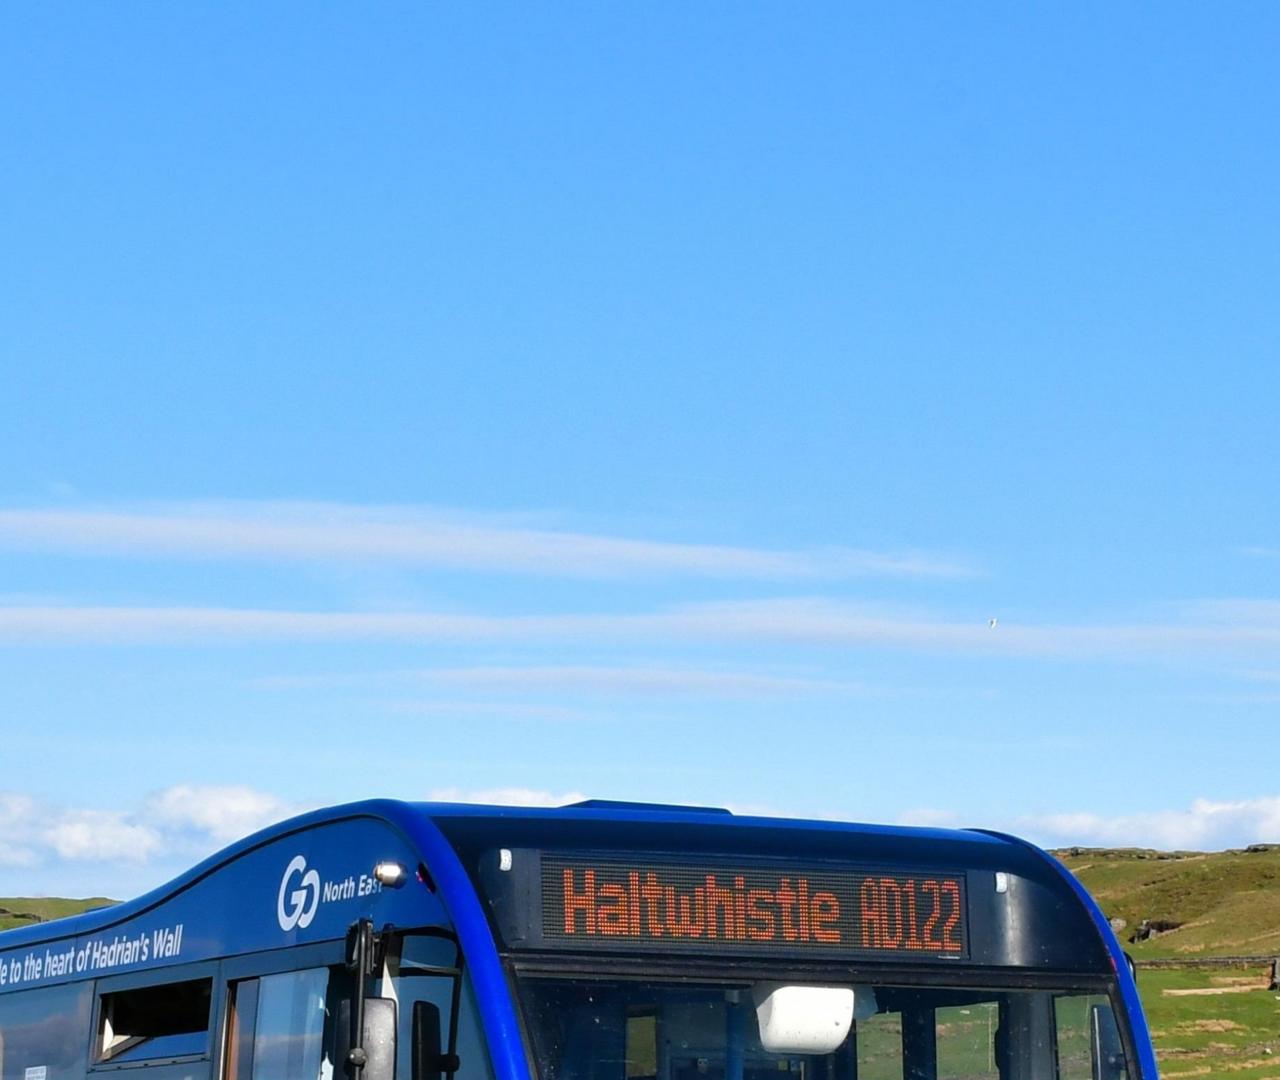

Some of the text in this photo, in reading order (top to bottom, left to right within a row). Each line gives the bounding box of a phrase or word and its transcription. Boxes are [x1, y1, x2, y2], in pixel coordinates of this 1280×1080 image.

[322, 876, 355, 903] North
[563, 869, 962, 951] Haltwhistle AD122
[9, 957, 21, 984] to
[23, 952, 41, 981] the
[43, 946, 75, 979] heart
[76, 941, 92, 972] of
[91, 932, 149, 970] Hadrian's
[152, 924, 184, 960] Wall
